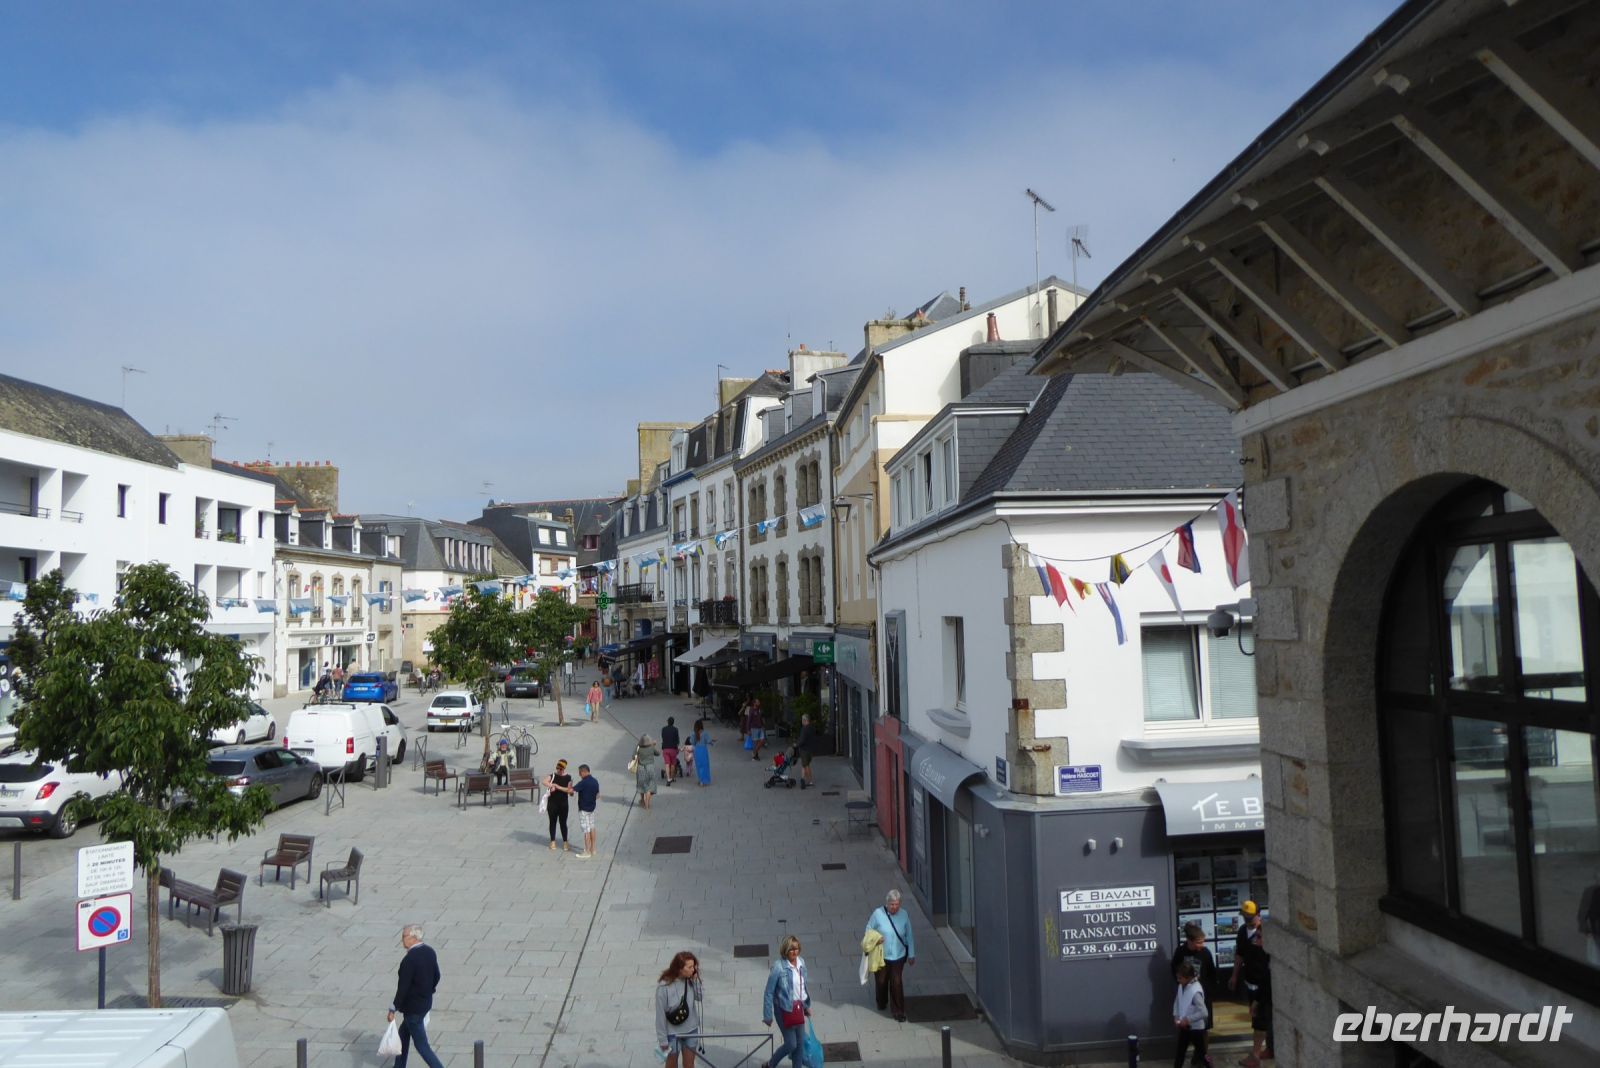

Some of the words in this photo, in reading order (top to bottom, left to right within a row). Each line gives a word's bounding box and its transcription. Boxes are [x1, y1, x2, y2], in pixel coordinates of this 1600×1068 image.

[1242, 797, 1262, 815] B
[1201, 821, 1264, 831] IMMO
[100, 857, 126, 865] MINUTES
[1090, 889, 1151, 901] BIAVANT
[1066, 901, 1151, 910] IMMOBILIER
[1083, 911, 1131, 924] TOUTES
[1062, 924, 1157, 940] TRANSACTIONS
[1062, 940, 1157, 955] 02.98.60.40.10
